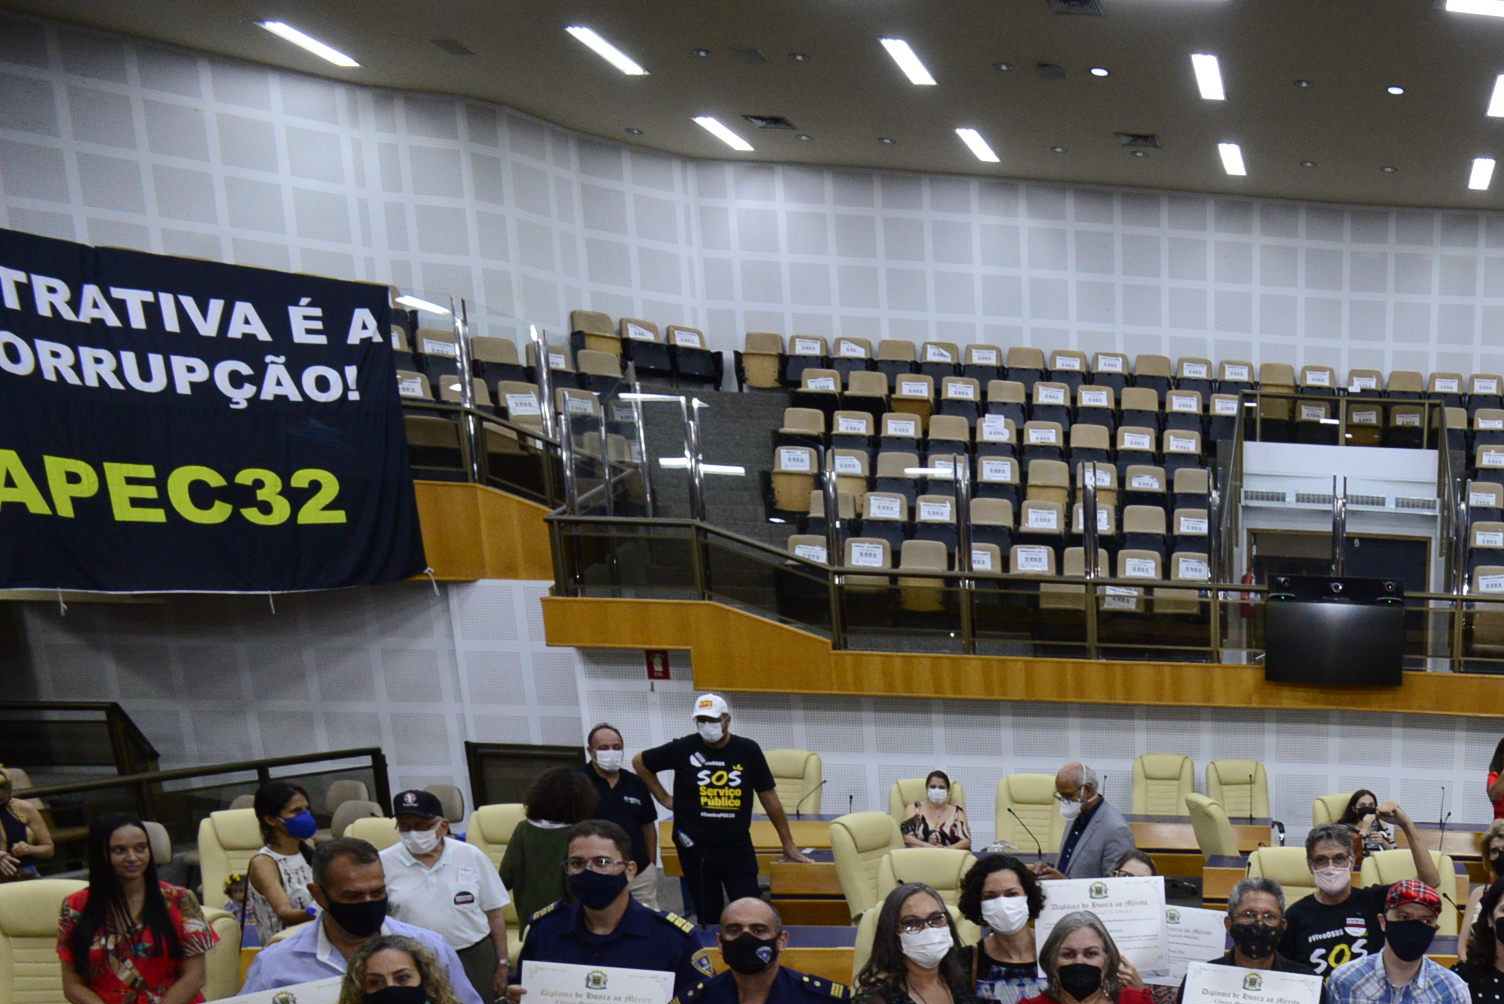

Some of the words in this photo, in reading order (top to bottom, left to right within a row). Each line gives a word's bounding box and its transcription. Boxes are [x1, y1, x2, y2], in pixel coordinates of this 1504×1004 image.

[0, 265, 272, 342] TRATIVA
[288, 297, 328, 344] É
[346, 308, 384, 344] A
[0, 330, 360, 410] ORRUPÇÃO!
[0, 448, 347, 526] APEC32
[697, 770, 742, 786] SOS
[700, 786, 742, 798] Serviço
[700, 796, 741, 806] Público
[1309, 938, 1368, 974] SOS
